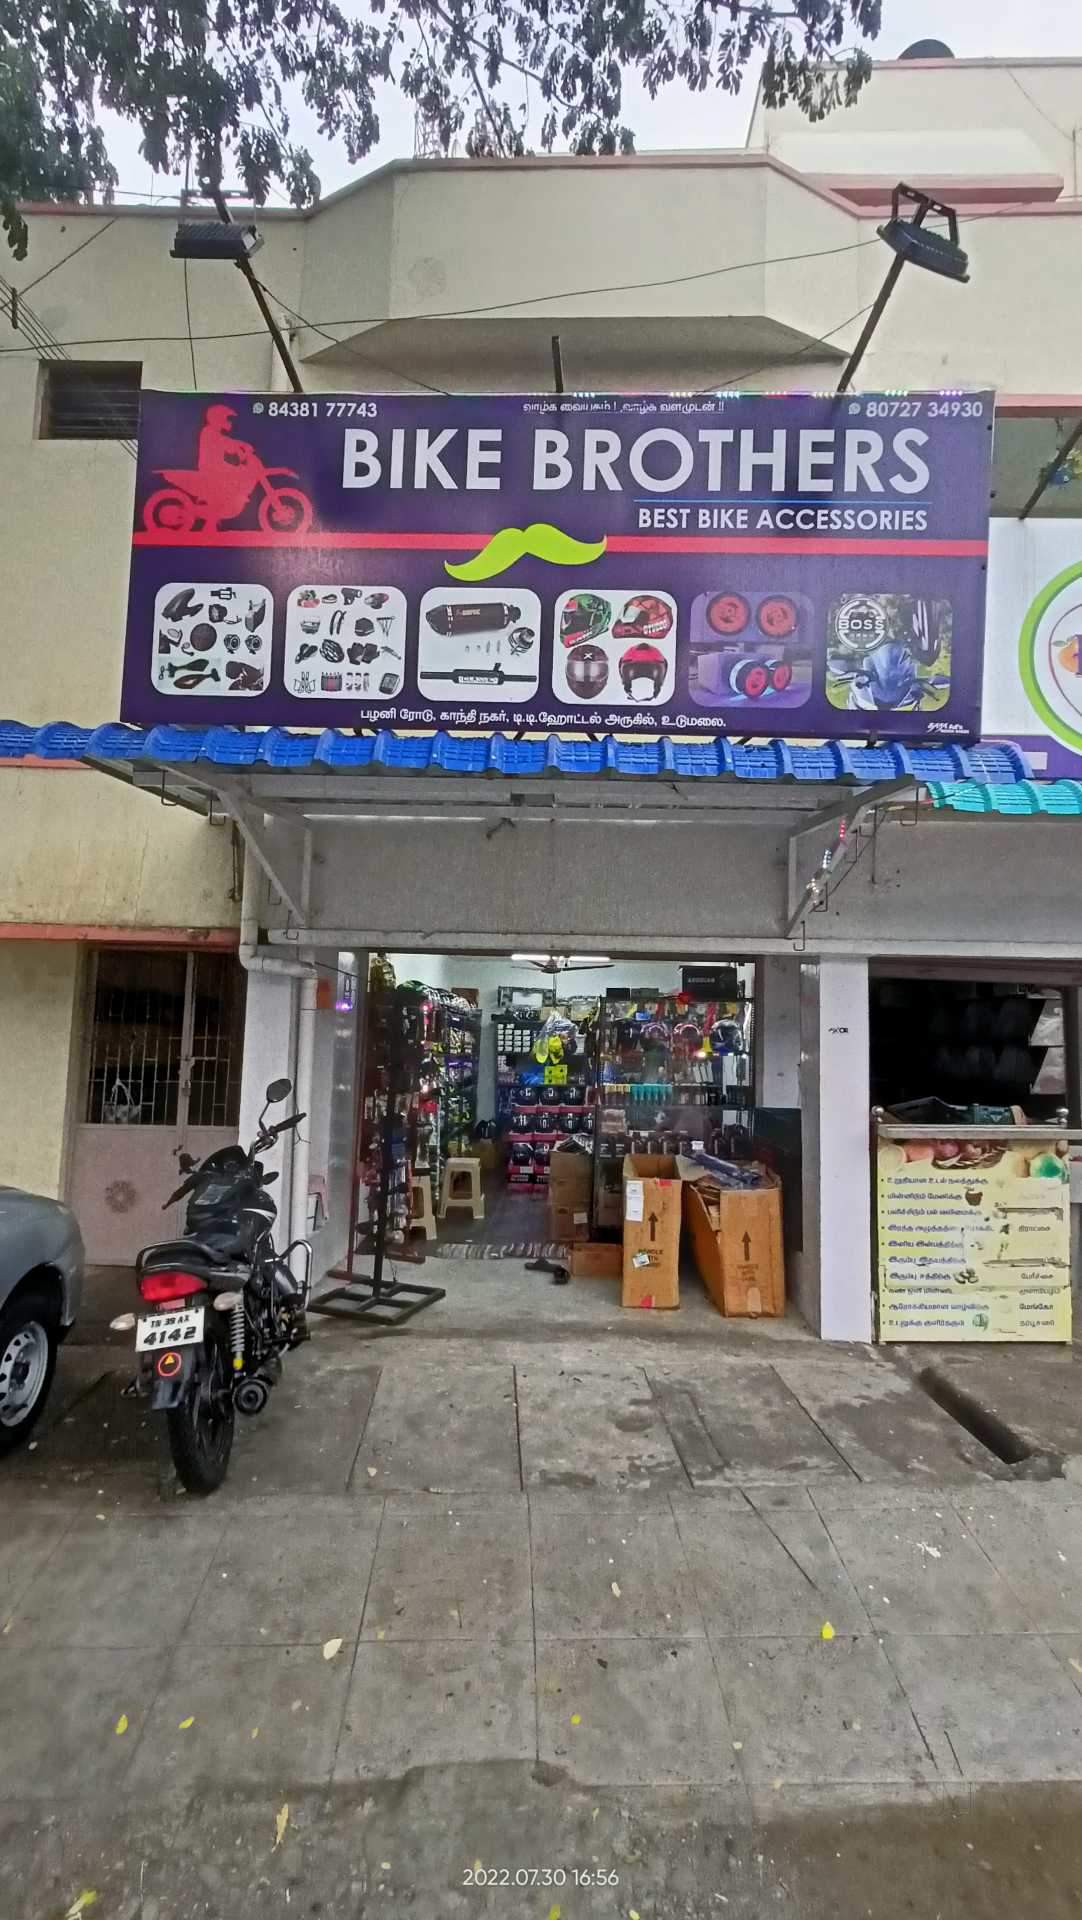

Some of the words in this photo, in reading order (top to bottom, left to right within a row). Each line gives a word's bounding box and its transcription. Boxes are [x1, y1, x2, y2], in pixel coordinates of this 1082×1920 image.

[268, 402, 318, 417] 84381
[326, 402, 377, 417] 77743
[660, 402, 715, 414] வளமுடன்
[866, 402, 919, 417] 80727
[927, 402, 983, 417] 34930
[342, 428, 503, 490] BIKE
[532, 427, 930, 494] BROTHERS
[638, 509, 690, 529] BEST
[698, 509, 748, 529] BIKE
[756, 508, 928, 531] ACCESSORIES
[360, 708, 397, 721] பழனி
[440, 708, 476, 725] காந்தி
[605, 712, 657, 728] அருகில்,
[661, 714, 726, 728] உடுமலை.
[143, 1326, 196, 1345] 4142
